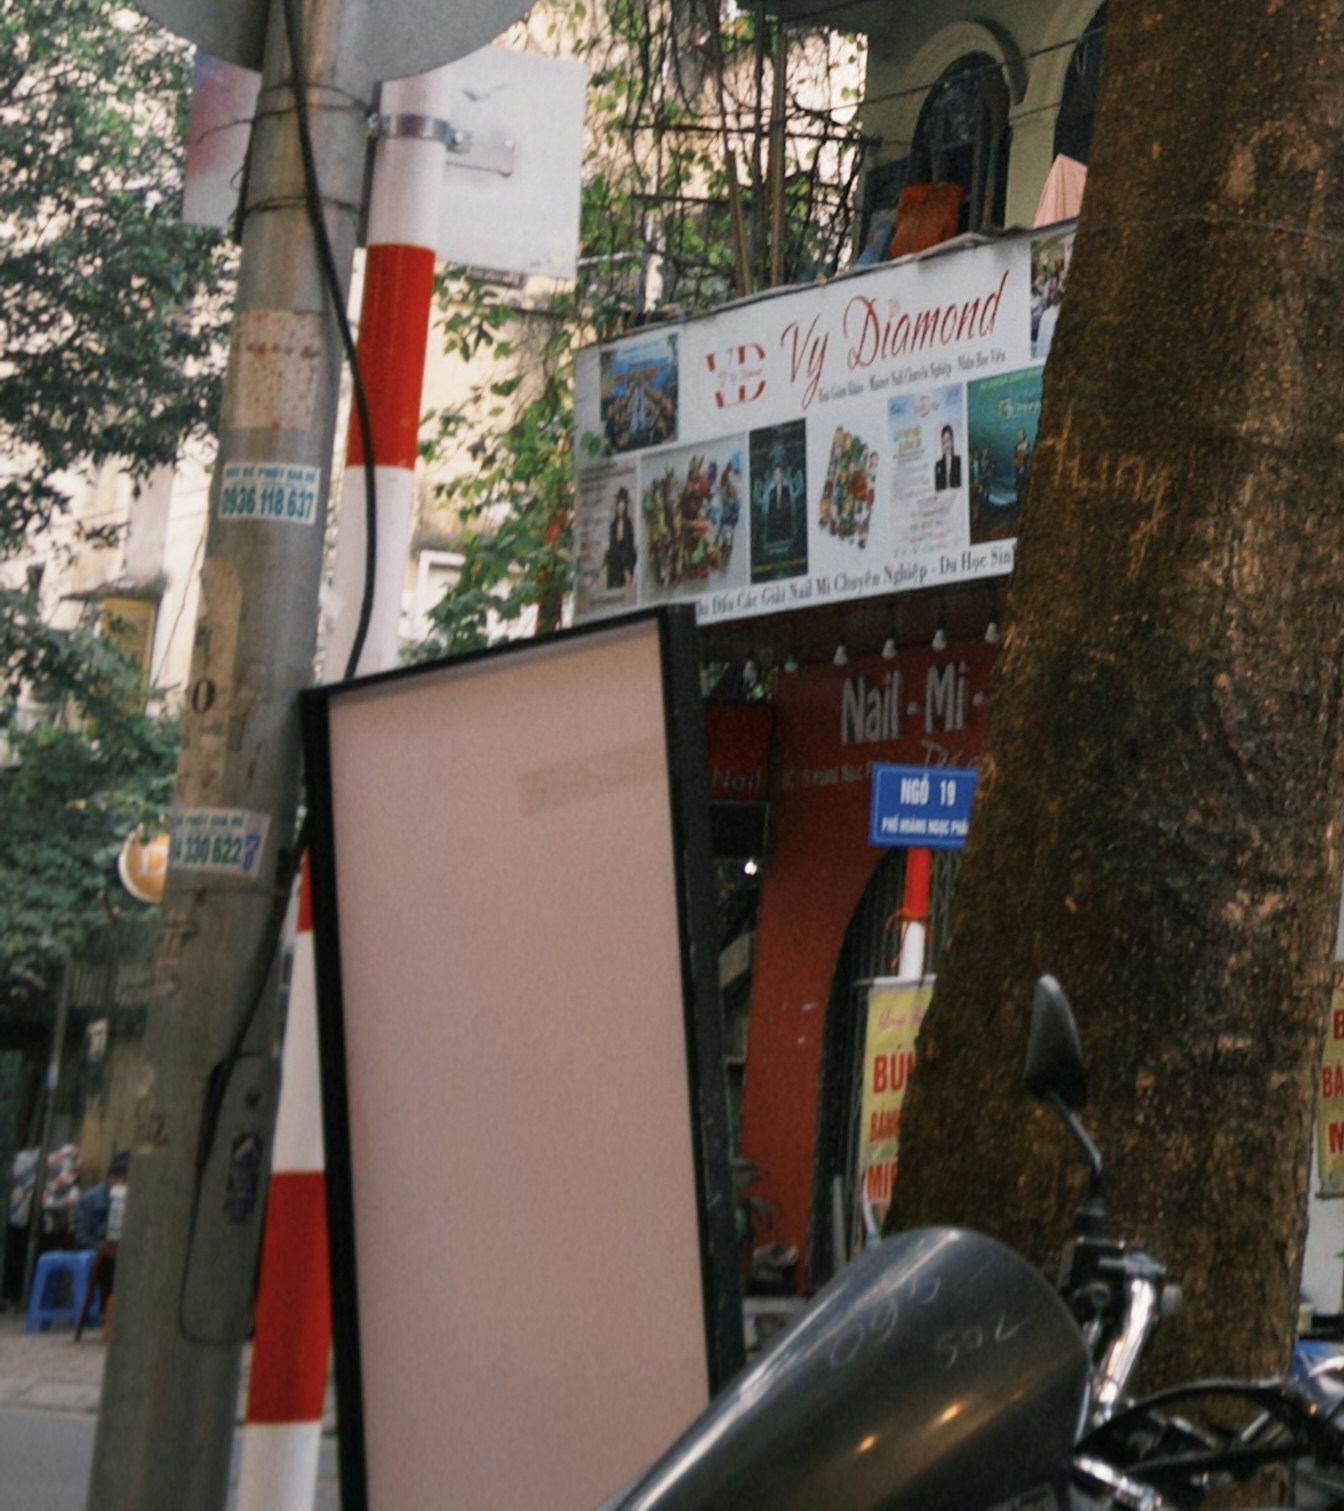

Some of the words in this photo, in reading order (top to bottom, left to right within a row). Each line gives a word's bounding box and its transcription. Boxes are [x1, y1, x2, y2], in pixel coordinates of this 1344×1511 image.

[780, 313, 829, 411] Vy
[843, 270, 1009, 370] Diamond
[222, 486, 256, 514] 0936
[260, 487, 285, 516] 118
[287, 488, 315, 520] 637
[990, 544, 1017, 567] Sin
[841, 670, 903, 746] Nail
[925, 661, 968, 734] Mi
[940, 778, 957, 807] 19
